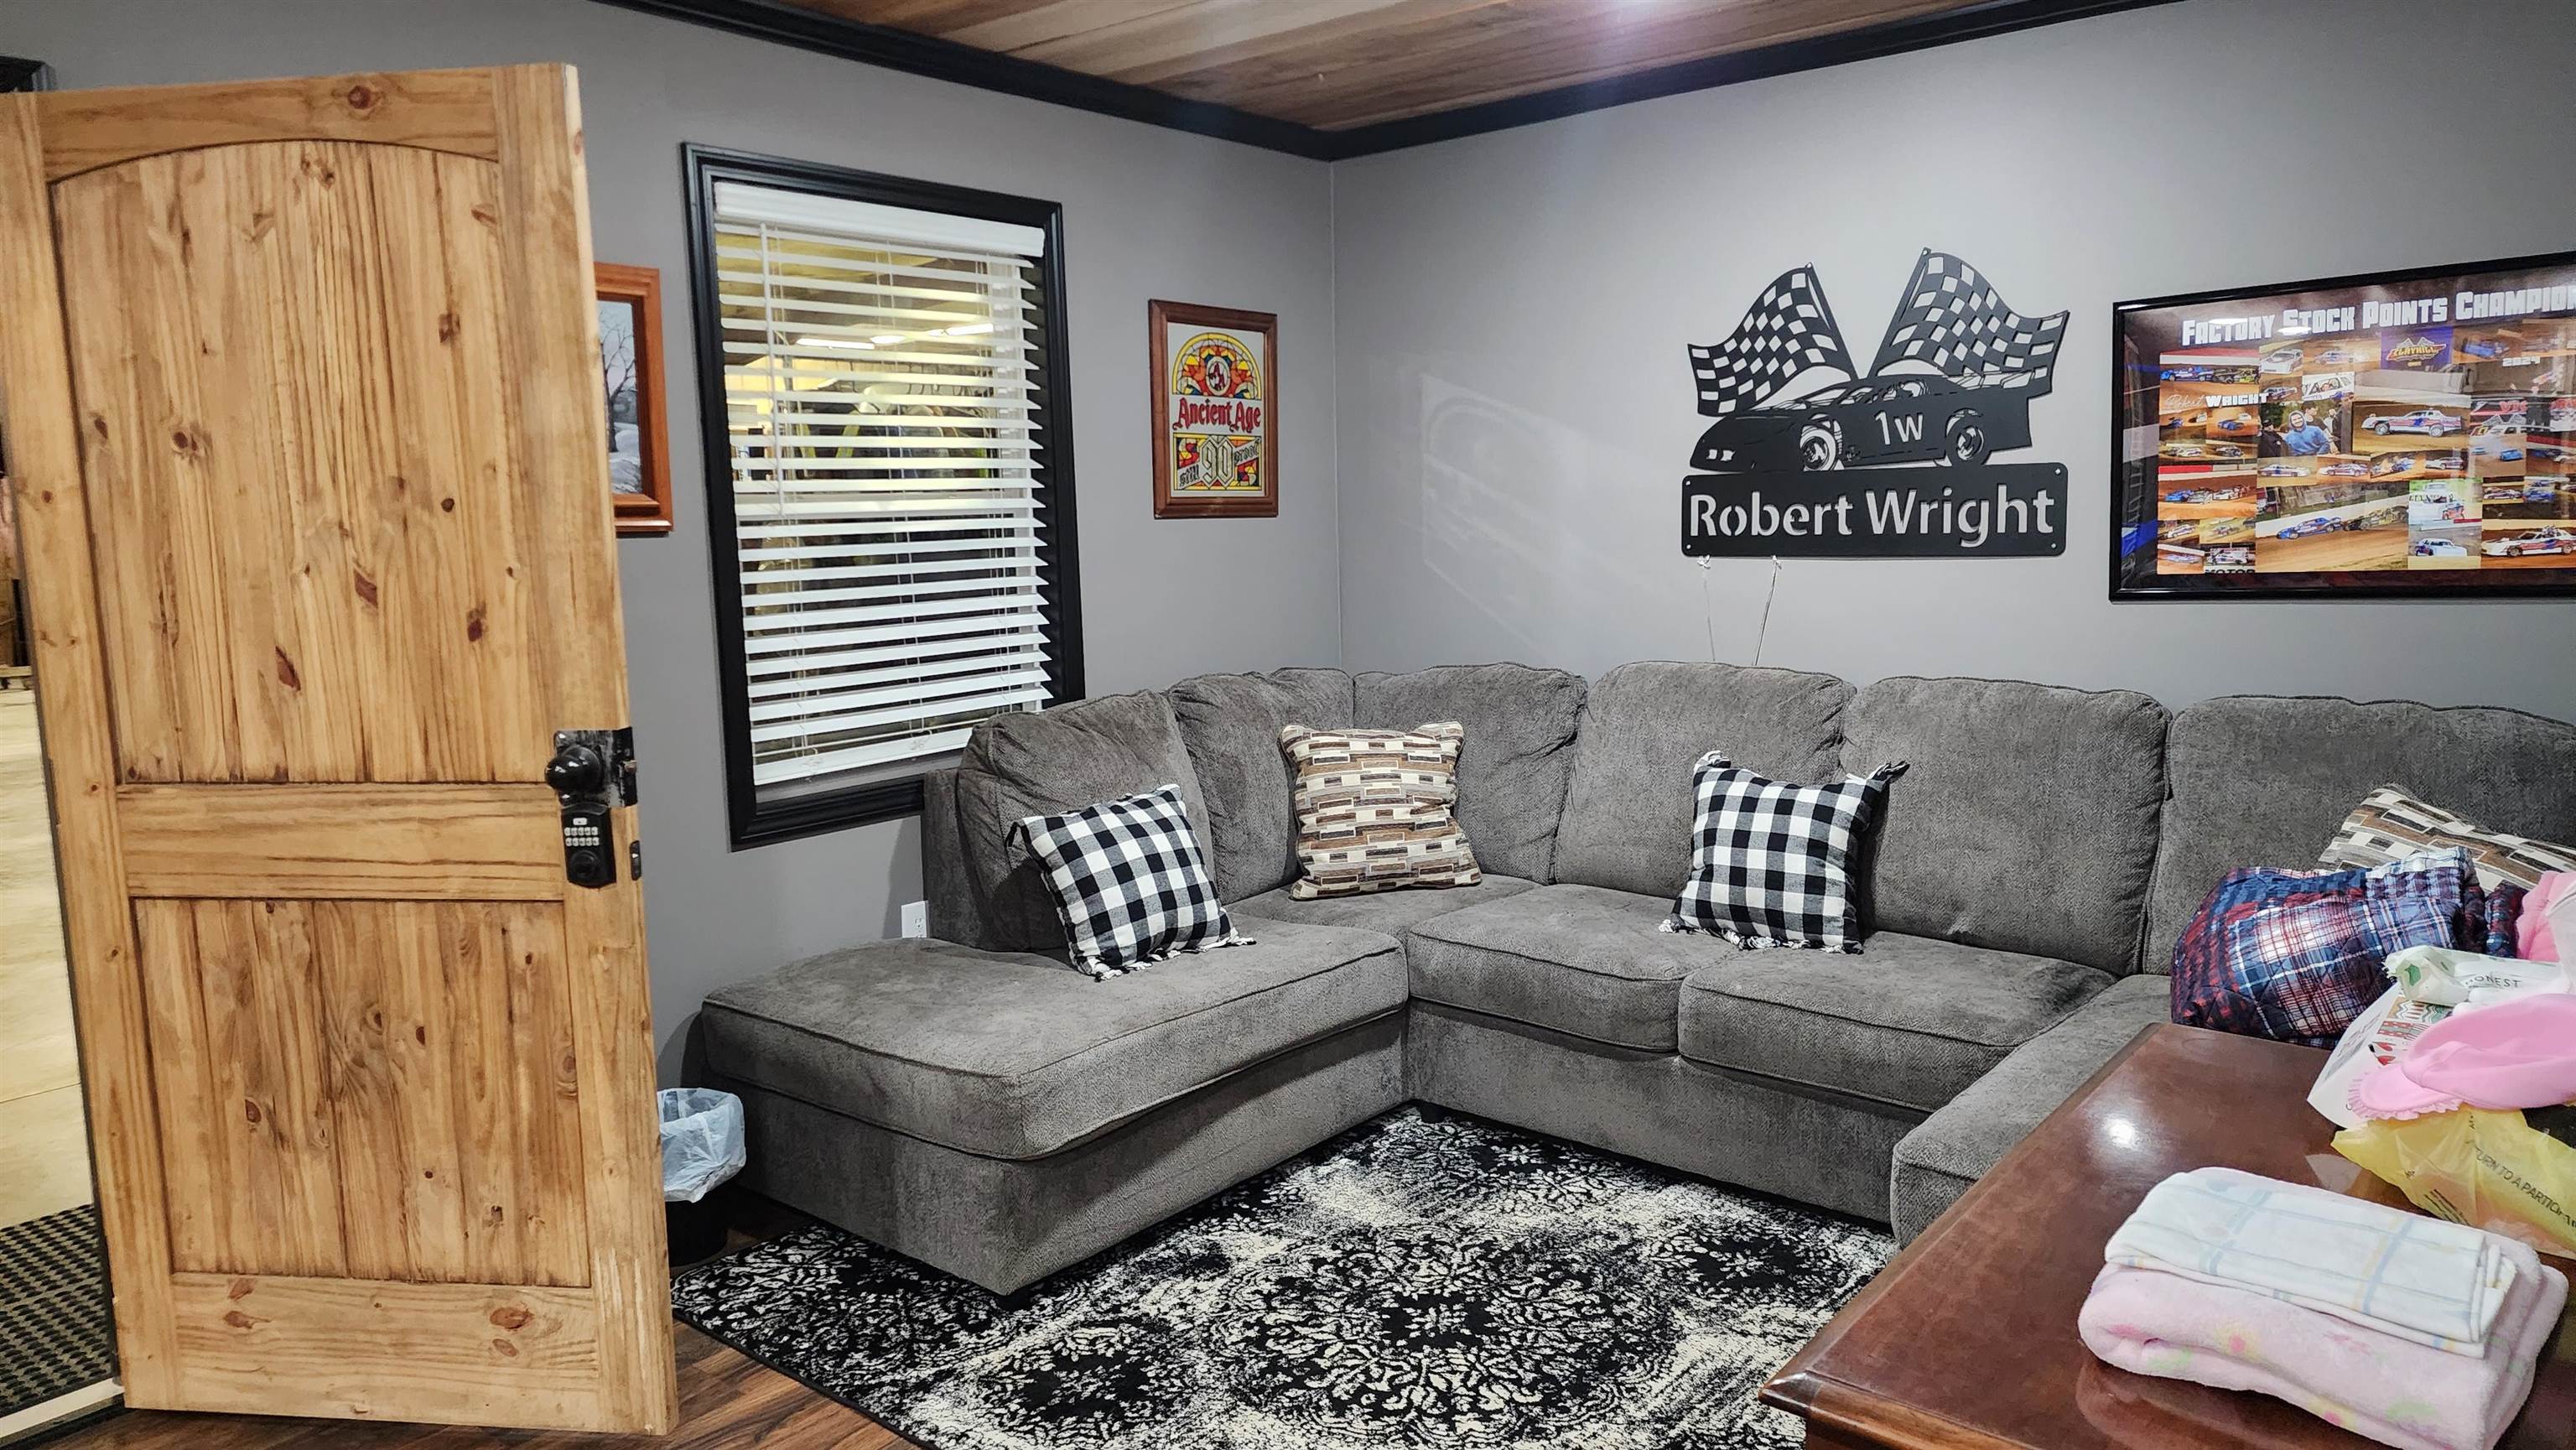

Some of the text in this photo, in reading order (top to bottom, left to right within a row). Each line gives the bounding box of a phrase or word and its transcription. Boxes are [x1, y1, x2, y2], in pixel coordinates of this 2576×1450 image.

[2182, 314, 2276, 346] FACTORY
[2282, 306, 2355, 336] STOCK
[2362, 297, 2448, 330] POINTS
[1172, 397, 1261, 434] Ancient Age
[2205, 392, 2269, 408] WRIGHT
[1201, 438, 1234, 486] 90
[1689, 484, 2055, 548] Robert Wright
[2498, 1165, 2515, 1181] TO
[2511, 1177, 2523, 1188] A
